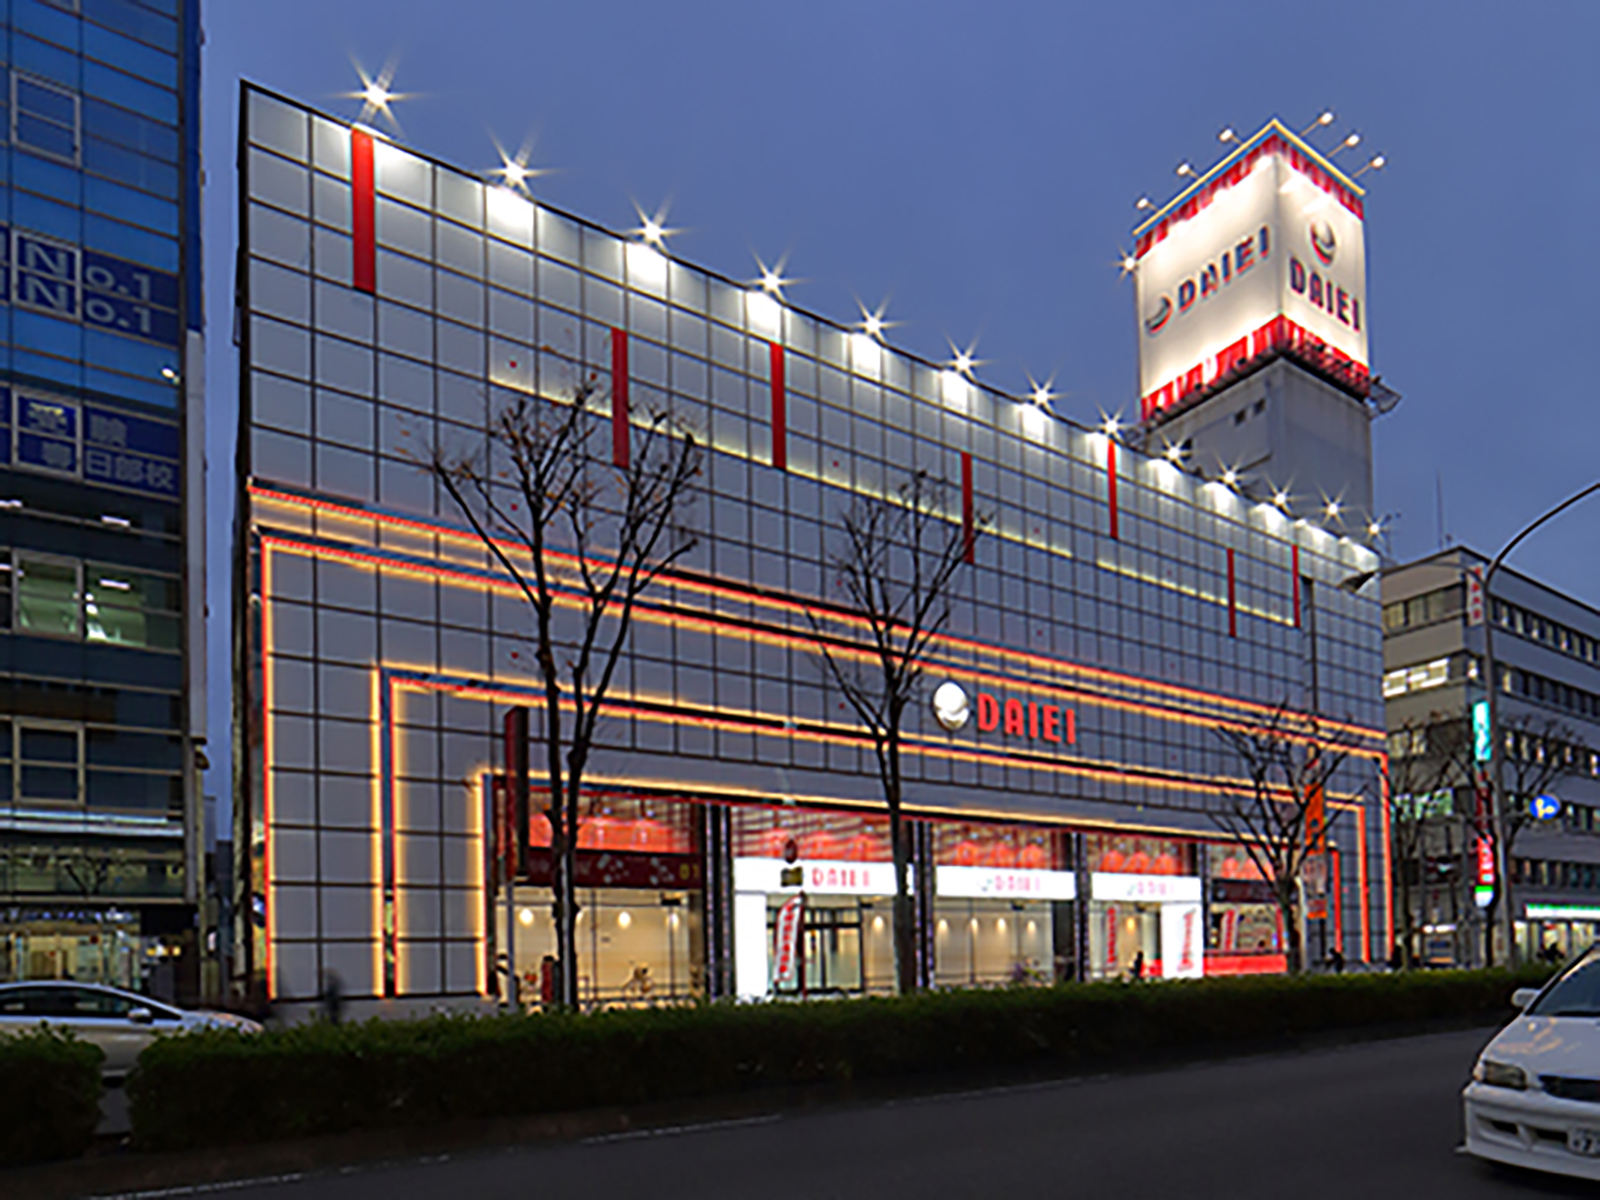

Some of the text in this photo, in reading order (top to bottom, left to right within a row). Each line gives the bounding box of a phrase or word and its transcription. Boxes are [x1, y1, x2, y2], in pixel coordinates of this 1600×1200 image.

[26, 242, 150, 299] No.1
[1178, 225, 1270, 312] DAIEI
[1290, 257, 1361, 332] DAIEI
[26, 276, 151, 333] No.1
[977, 692, 1076, 744] DAIEI
